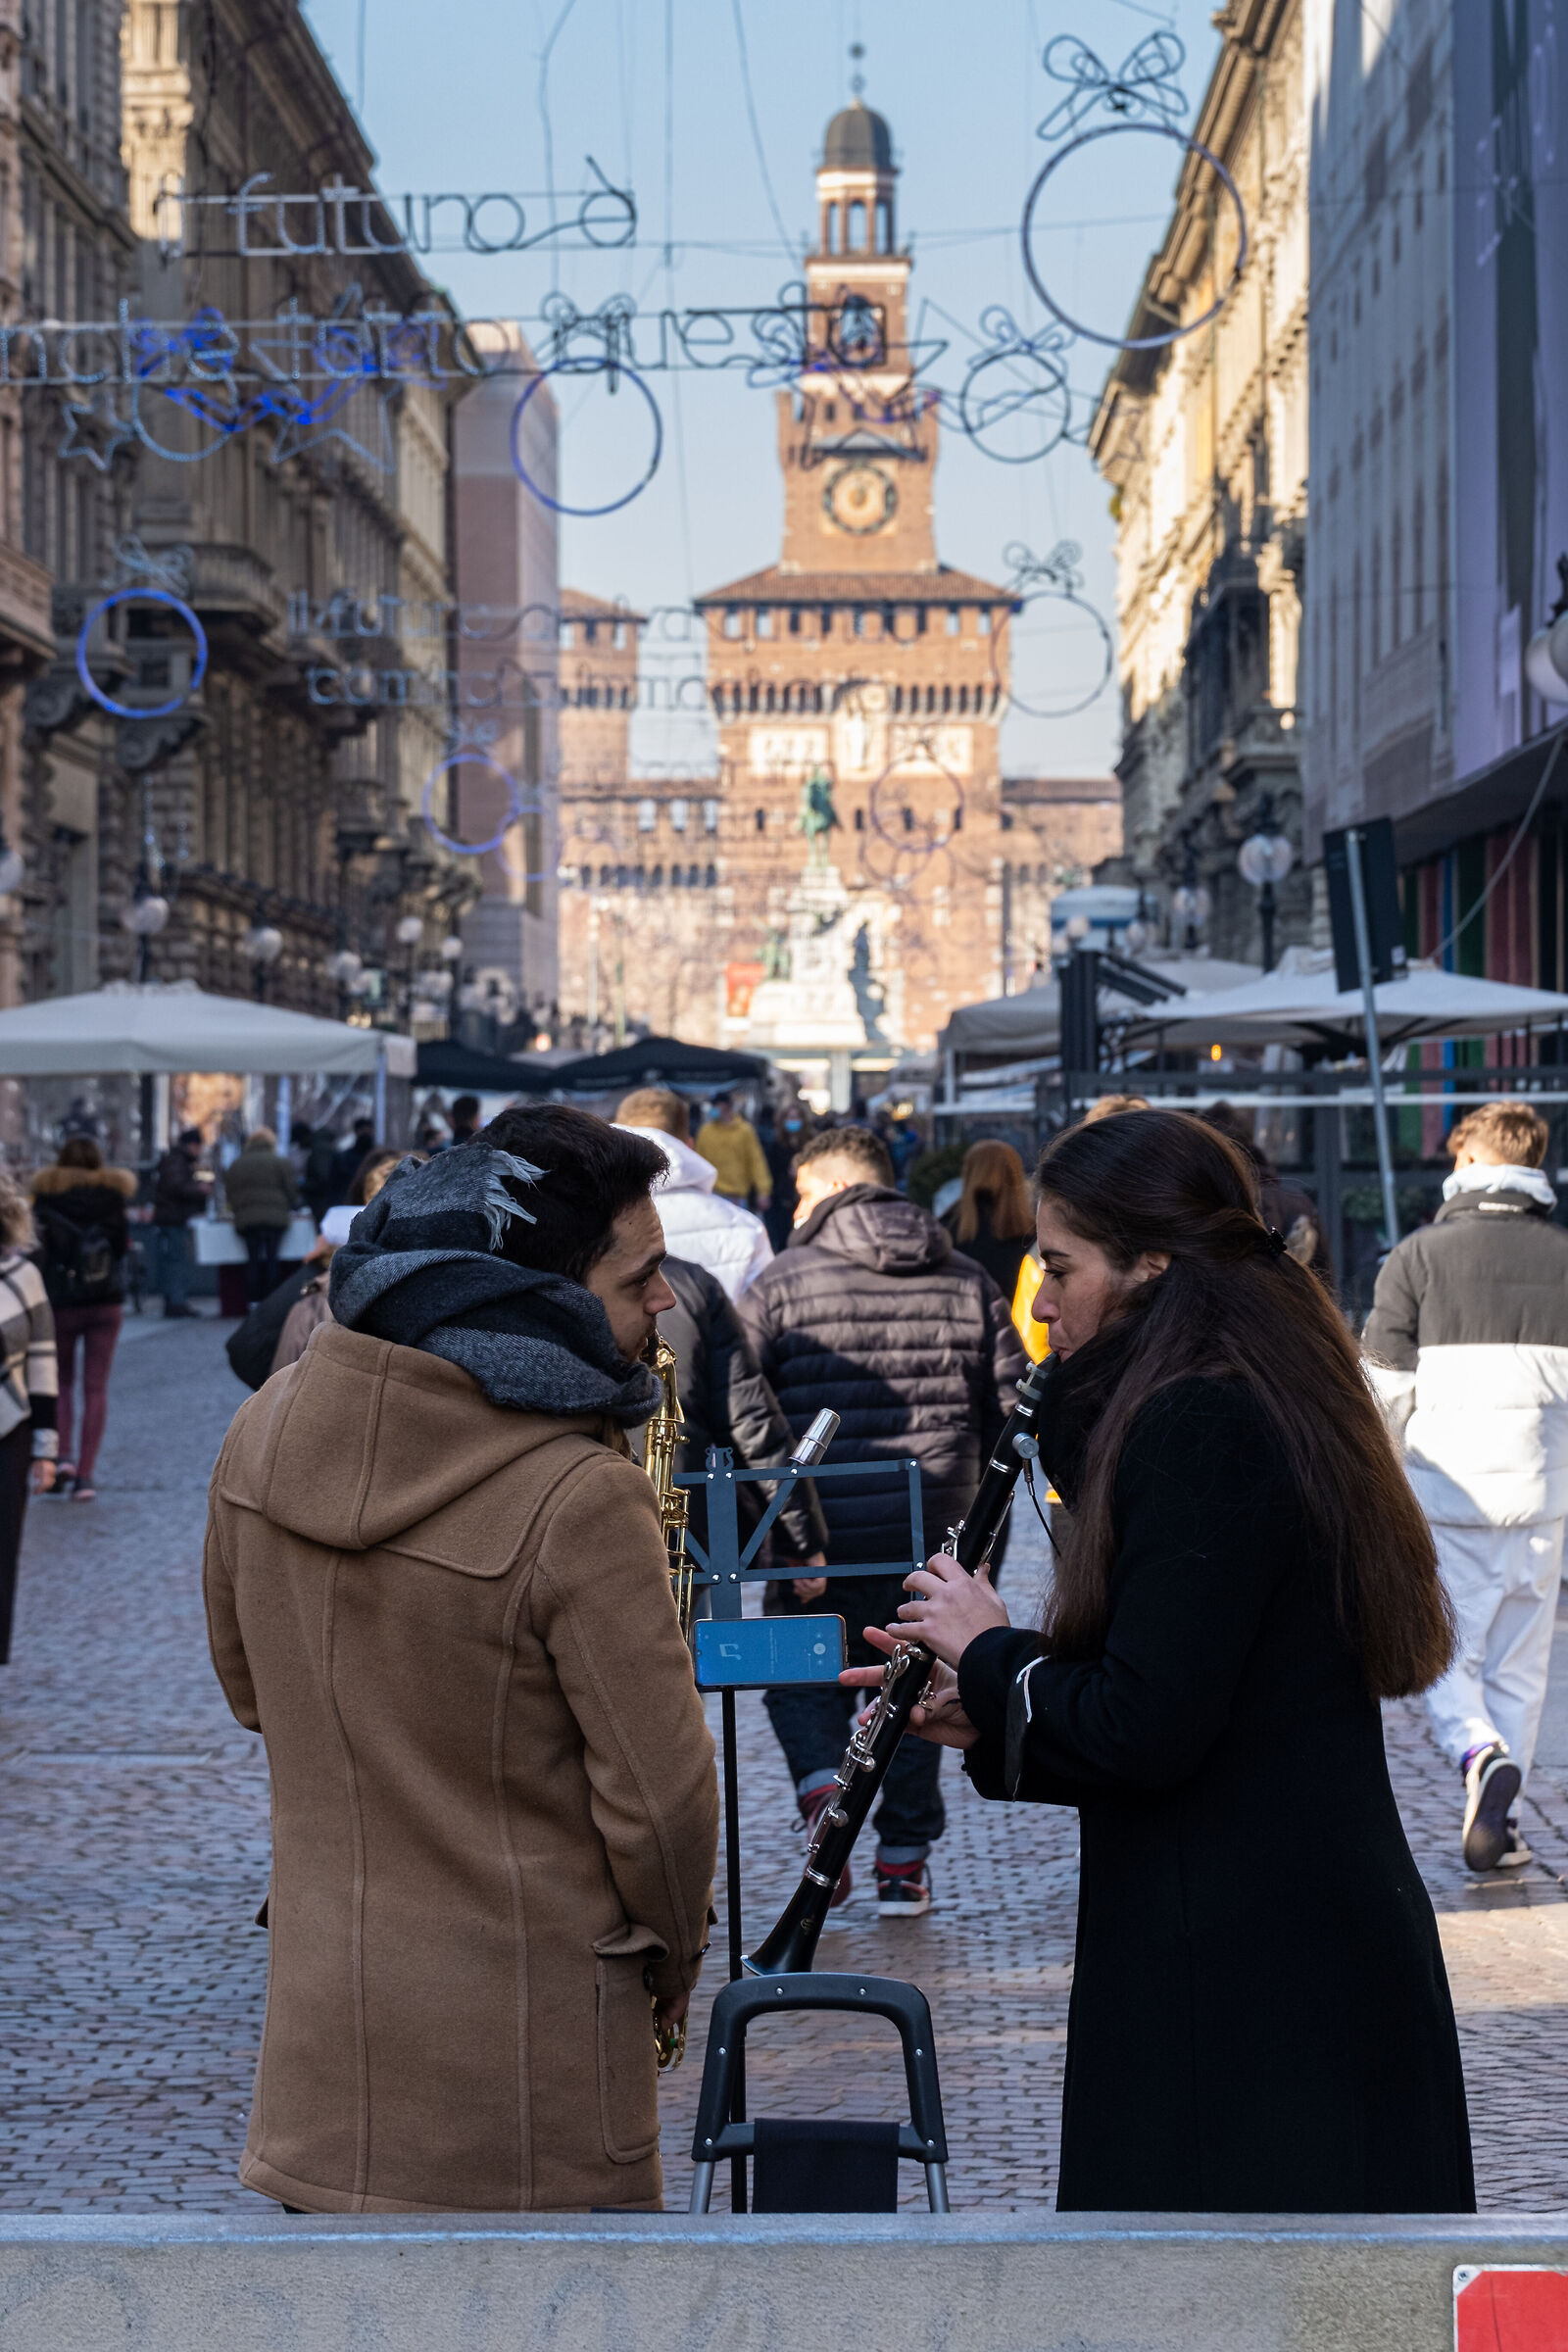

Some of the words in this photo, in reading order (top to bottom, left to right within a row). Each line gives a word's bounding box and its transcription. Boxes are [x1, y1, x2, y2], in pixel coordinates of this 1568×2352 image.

[225, 172, 524, 255] futuro
[0, 297, 238, 382] nche
[277, 297, 510, 378] tutto
